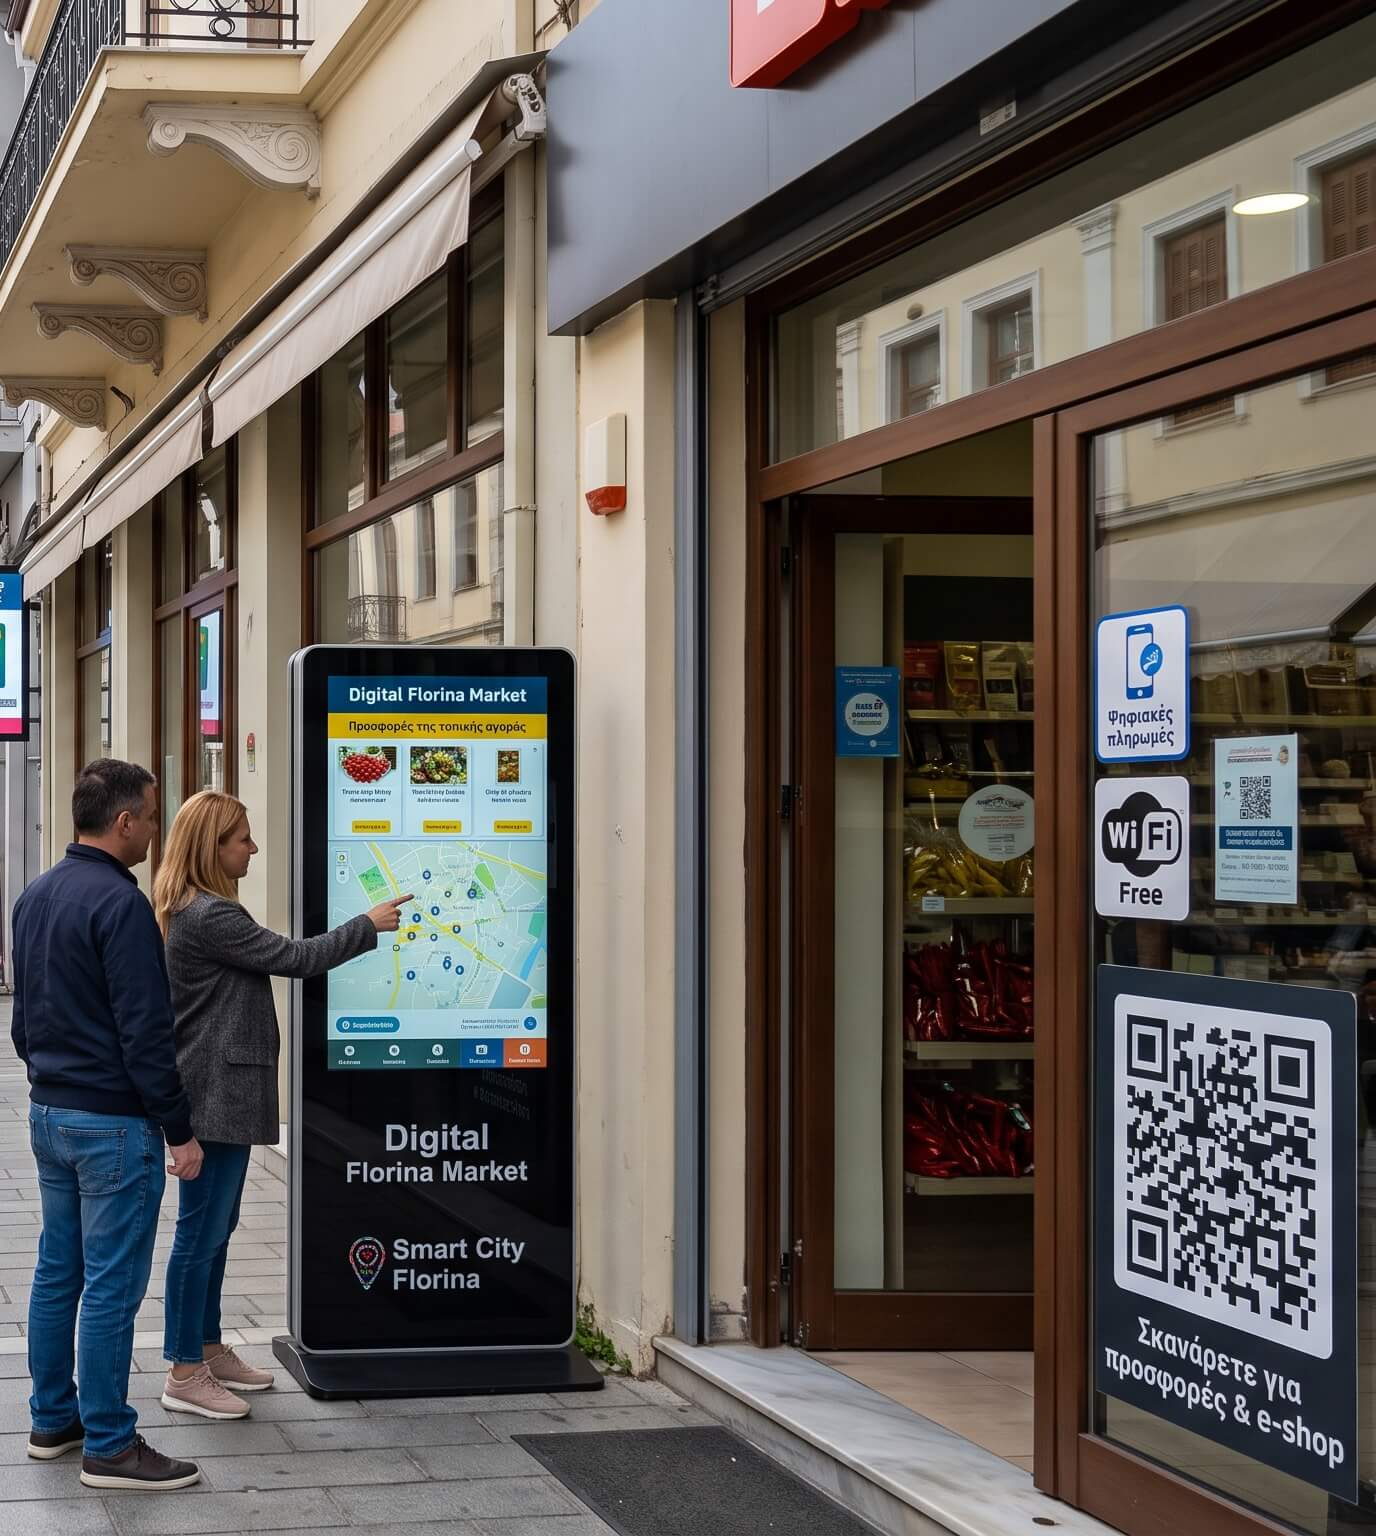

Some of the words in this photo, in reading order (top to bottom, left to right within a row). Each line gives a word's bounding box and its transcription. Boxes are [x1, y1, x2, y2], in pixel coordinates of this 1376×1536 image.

[349, 687, 403, 705] Digital
[408, 686, 465, 702] Florina
[469, 687, 527, 703] Market
[1108, 704, 1174, 727] Ψηφιακές
[417, 723, 436, 734] της
[439, 720, 483, 735] τοπικής
[486, 720, 526, 735] αγοράς
[1107, 727, 1175, 749] πληρωμές
[1119, 881, 1163, 906] Free
[385, 1123, 489, 1158] Digital
[346, 1162, 434, 1183] Florina
[442, 1160, 528, 1182] Market
[392, 1238, 468, 1260] Smart
[475, 1237, 526, 1264] City
[393, 1268, 480, 1291] Florina
[1137, 1316, 1258, 1388] Σκανάρετε
[1263, 1369, 1302, 1406] για
[1104, 1346, 1228, 1422] προσφορές
[1233, 1394, 1251, 1427] &
[1257, 1409, 1345, 1469] e-shop
